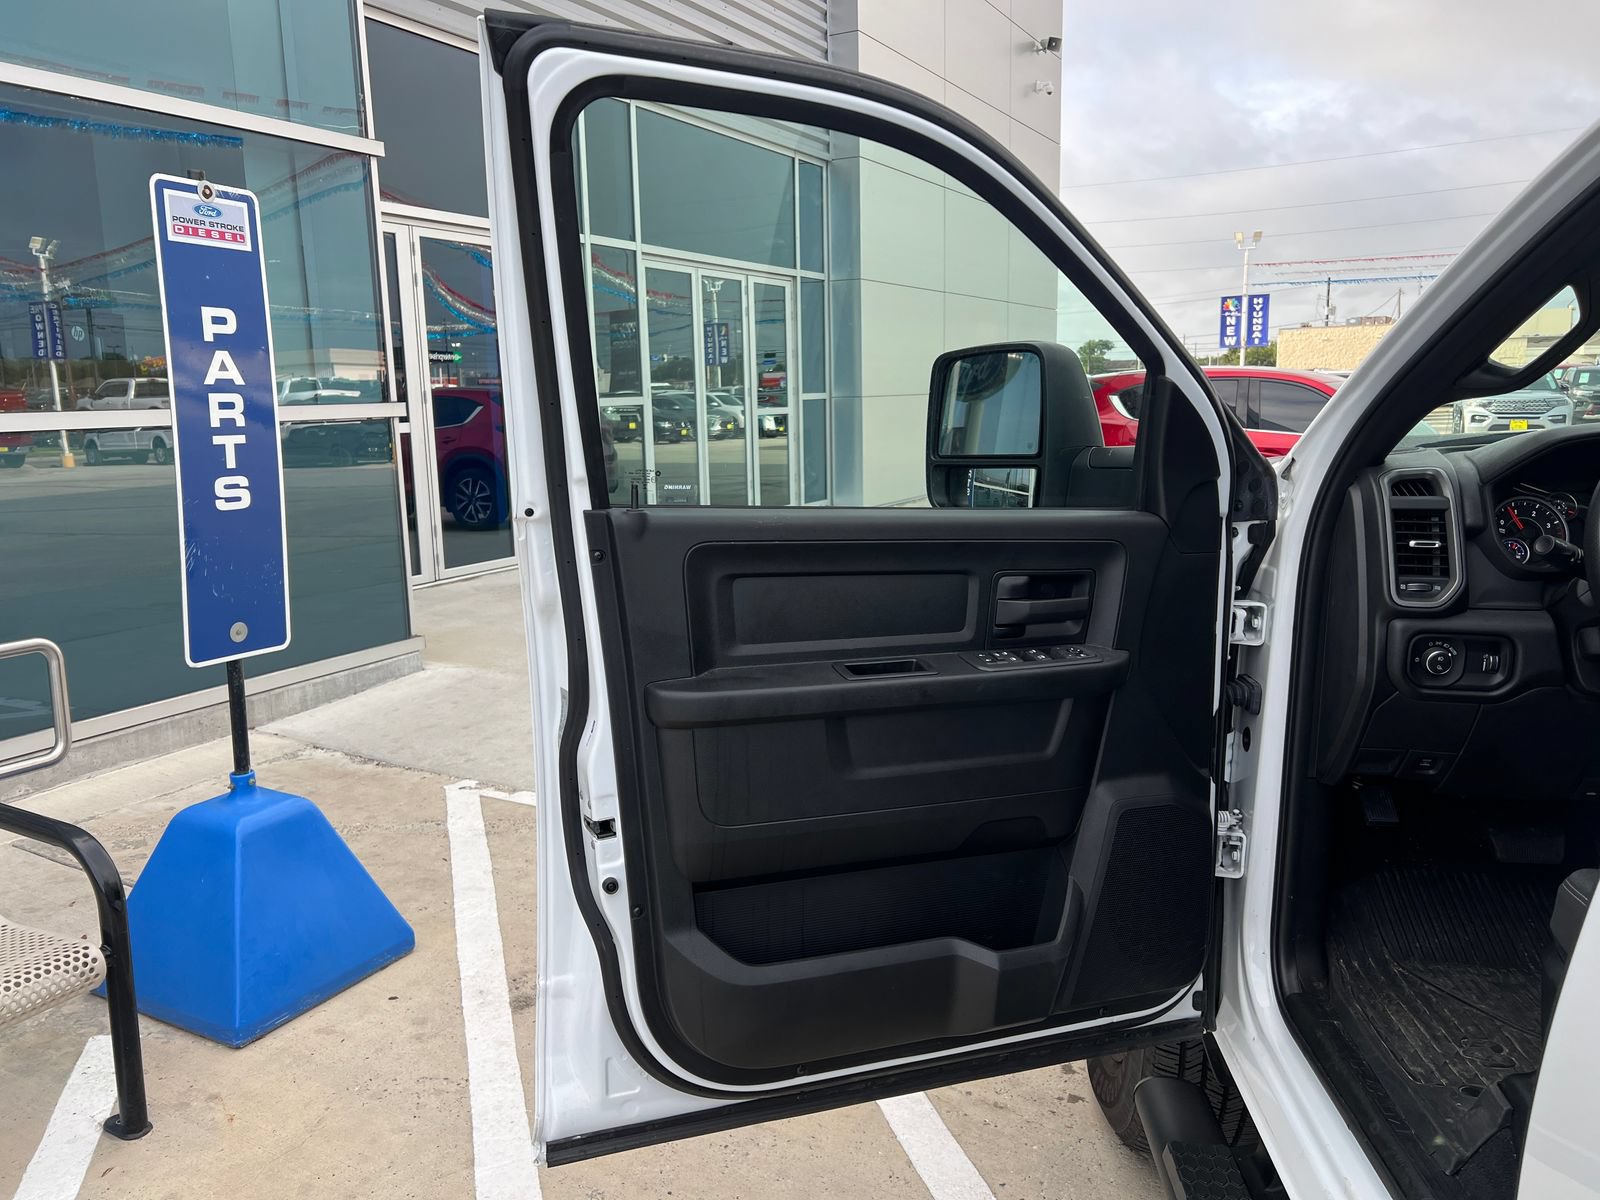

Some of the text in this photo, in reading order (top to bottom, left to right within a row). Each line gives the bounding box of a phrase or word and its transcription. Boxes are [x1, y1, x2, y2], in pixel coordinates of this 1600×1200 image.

[199, 205, 217, 217] Ford
[172, 216, 244, 232] POWER STROKE
[174, 226, 244, 242] DIESEL
[1224, 316, 1237, 346] NEW
[1252, 298, 1263, 345] HYUNDAI
[201, 306, 251, 511] PARTS
